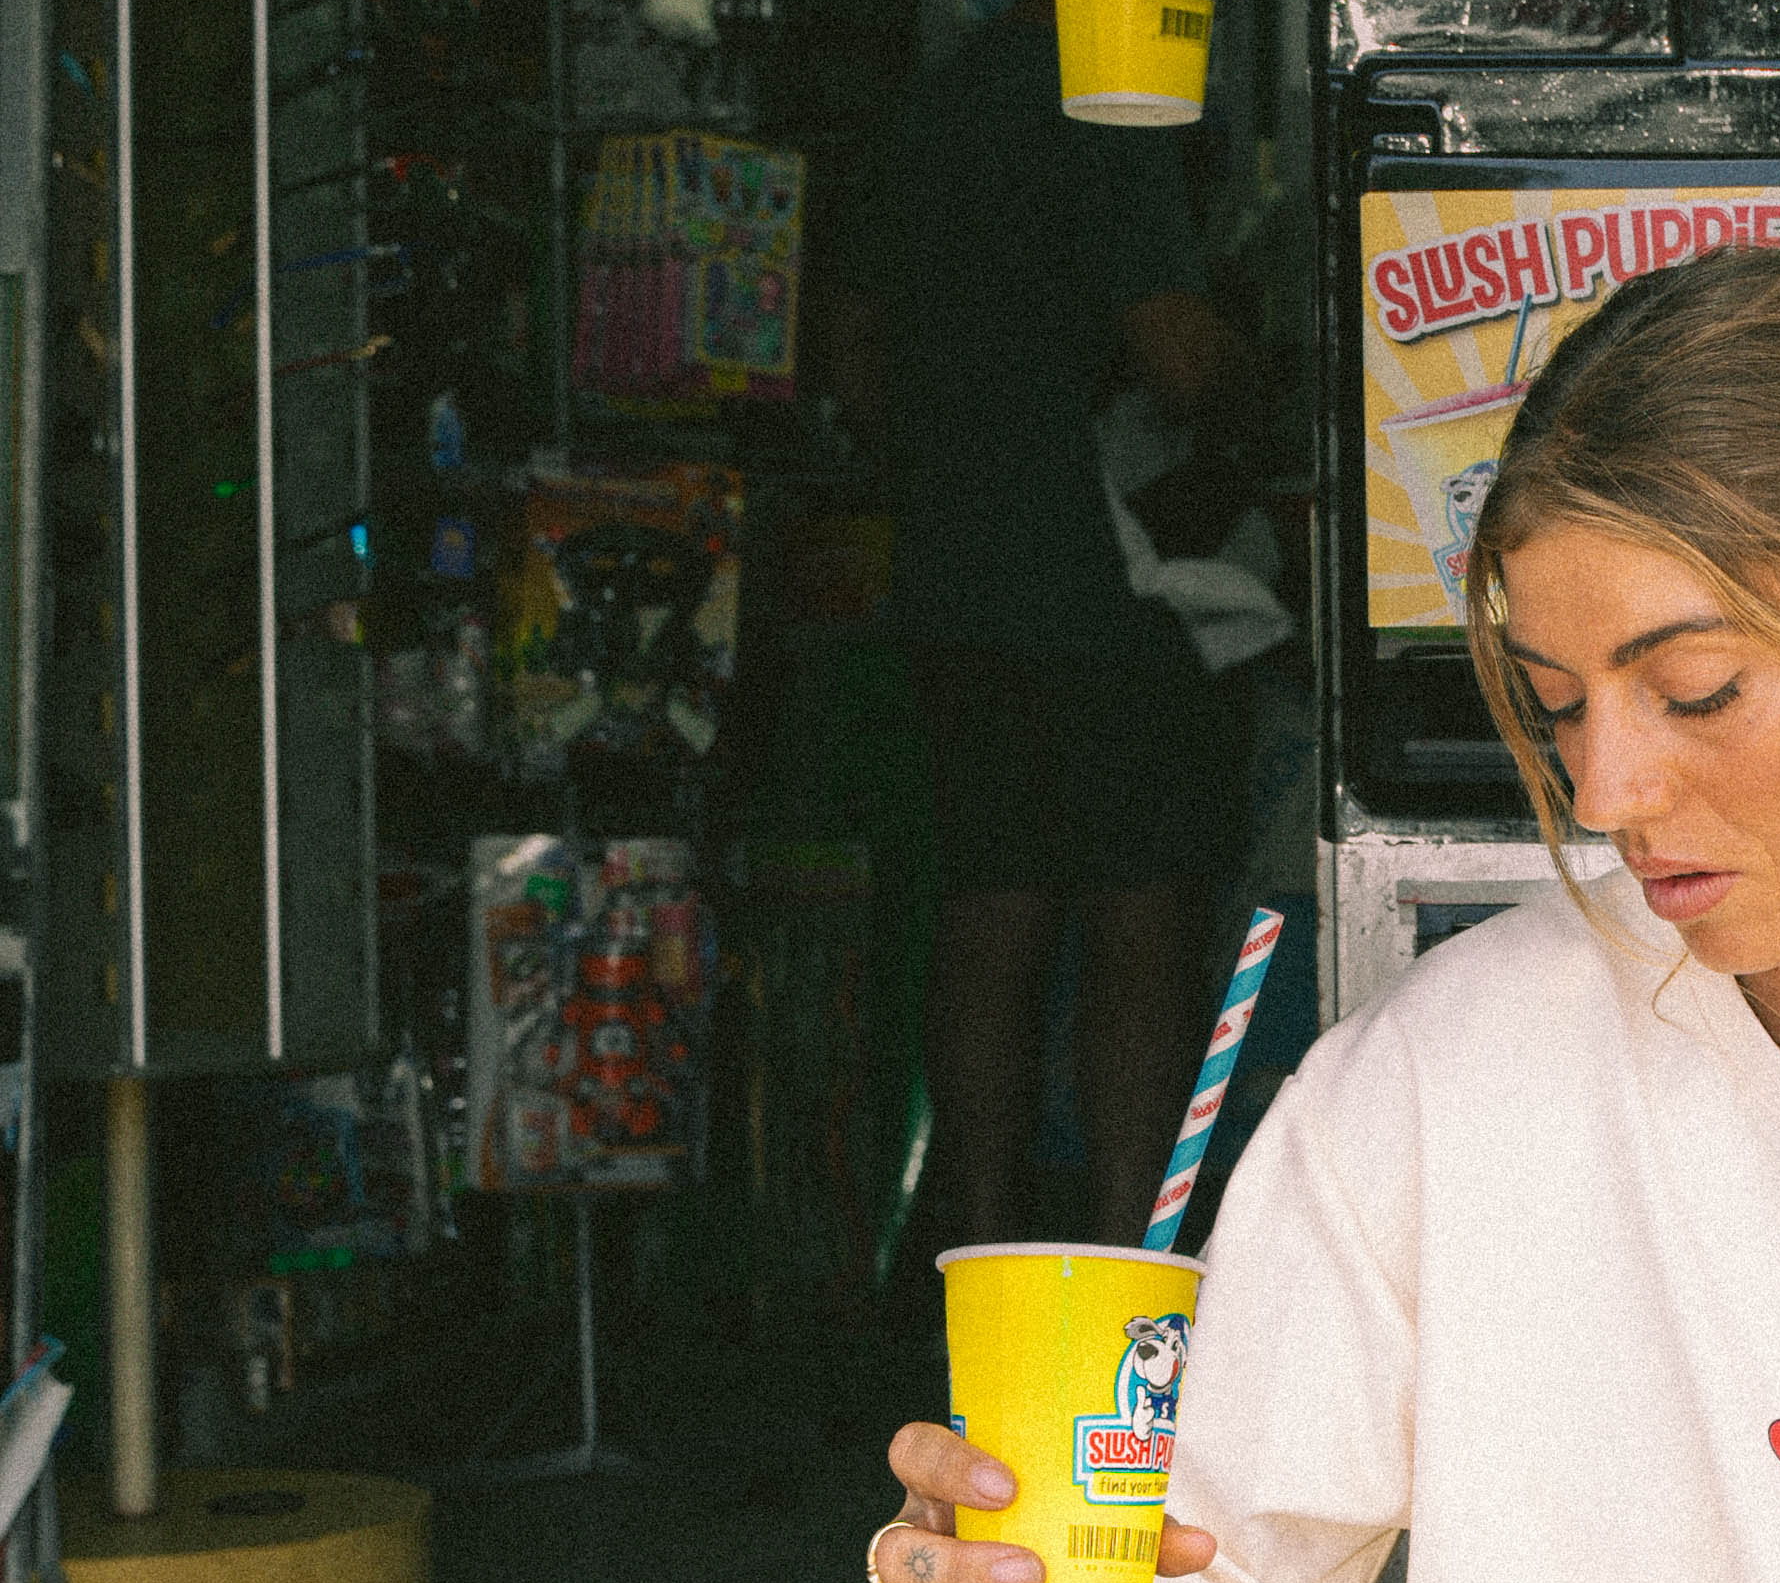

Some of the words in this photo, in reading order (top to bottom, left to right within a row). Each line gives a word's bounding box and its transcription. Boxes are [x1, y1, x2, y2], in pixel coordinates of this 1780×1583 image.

[1375, 222, 1551, 334] SLUSH
[1088, 1430, 1153, 1466] SLUSH
[1099, 1475, 1128, 1494] find
[1129, 1480, 1153, 1497] your
